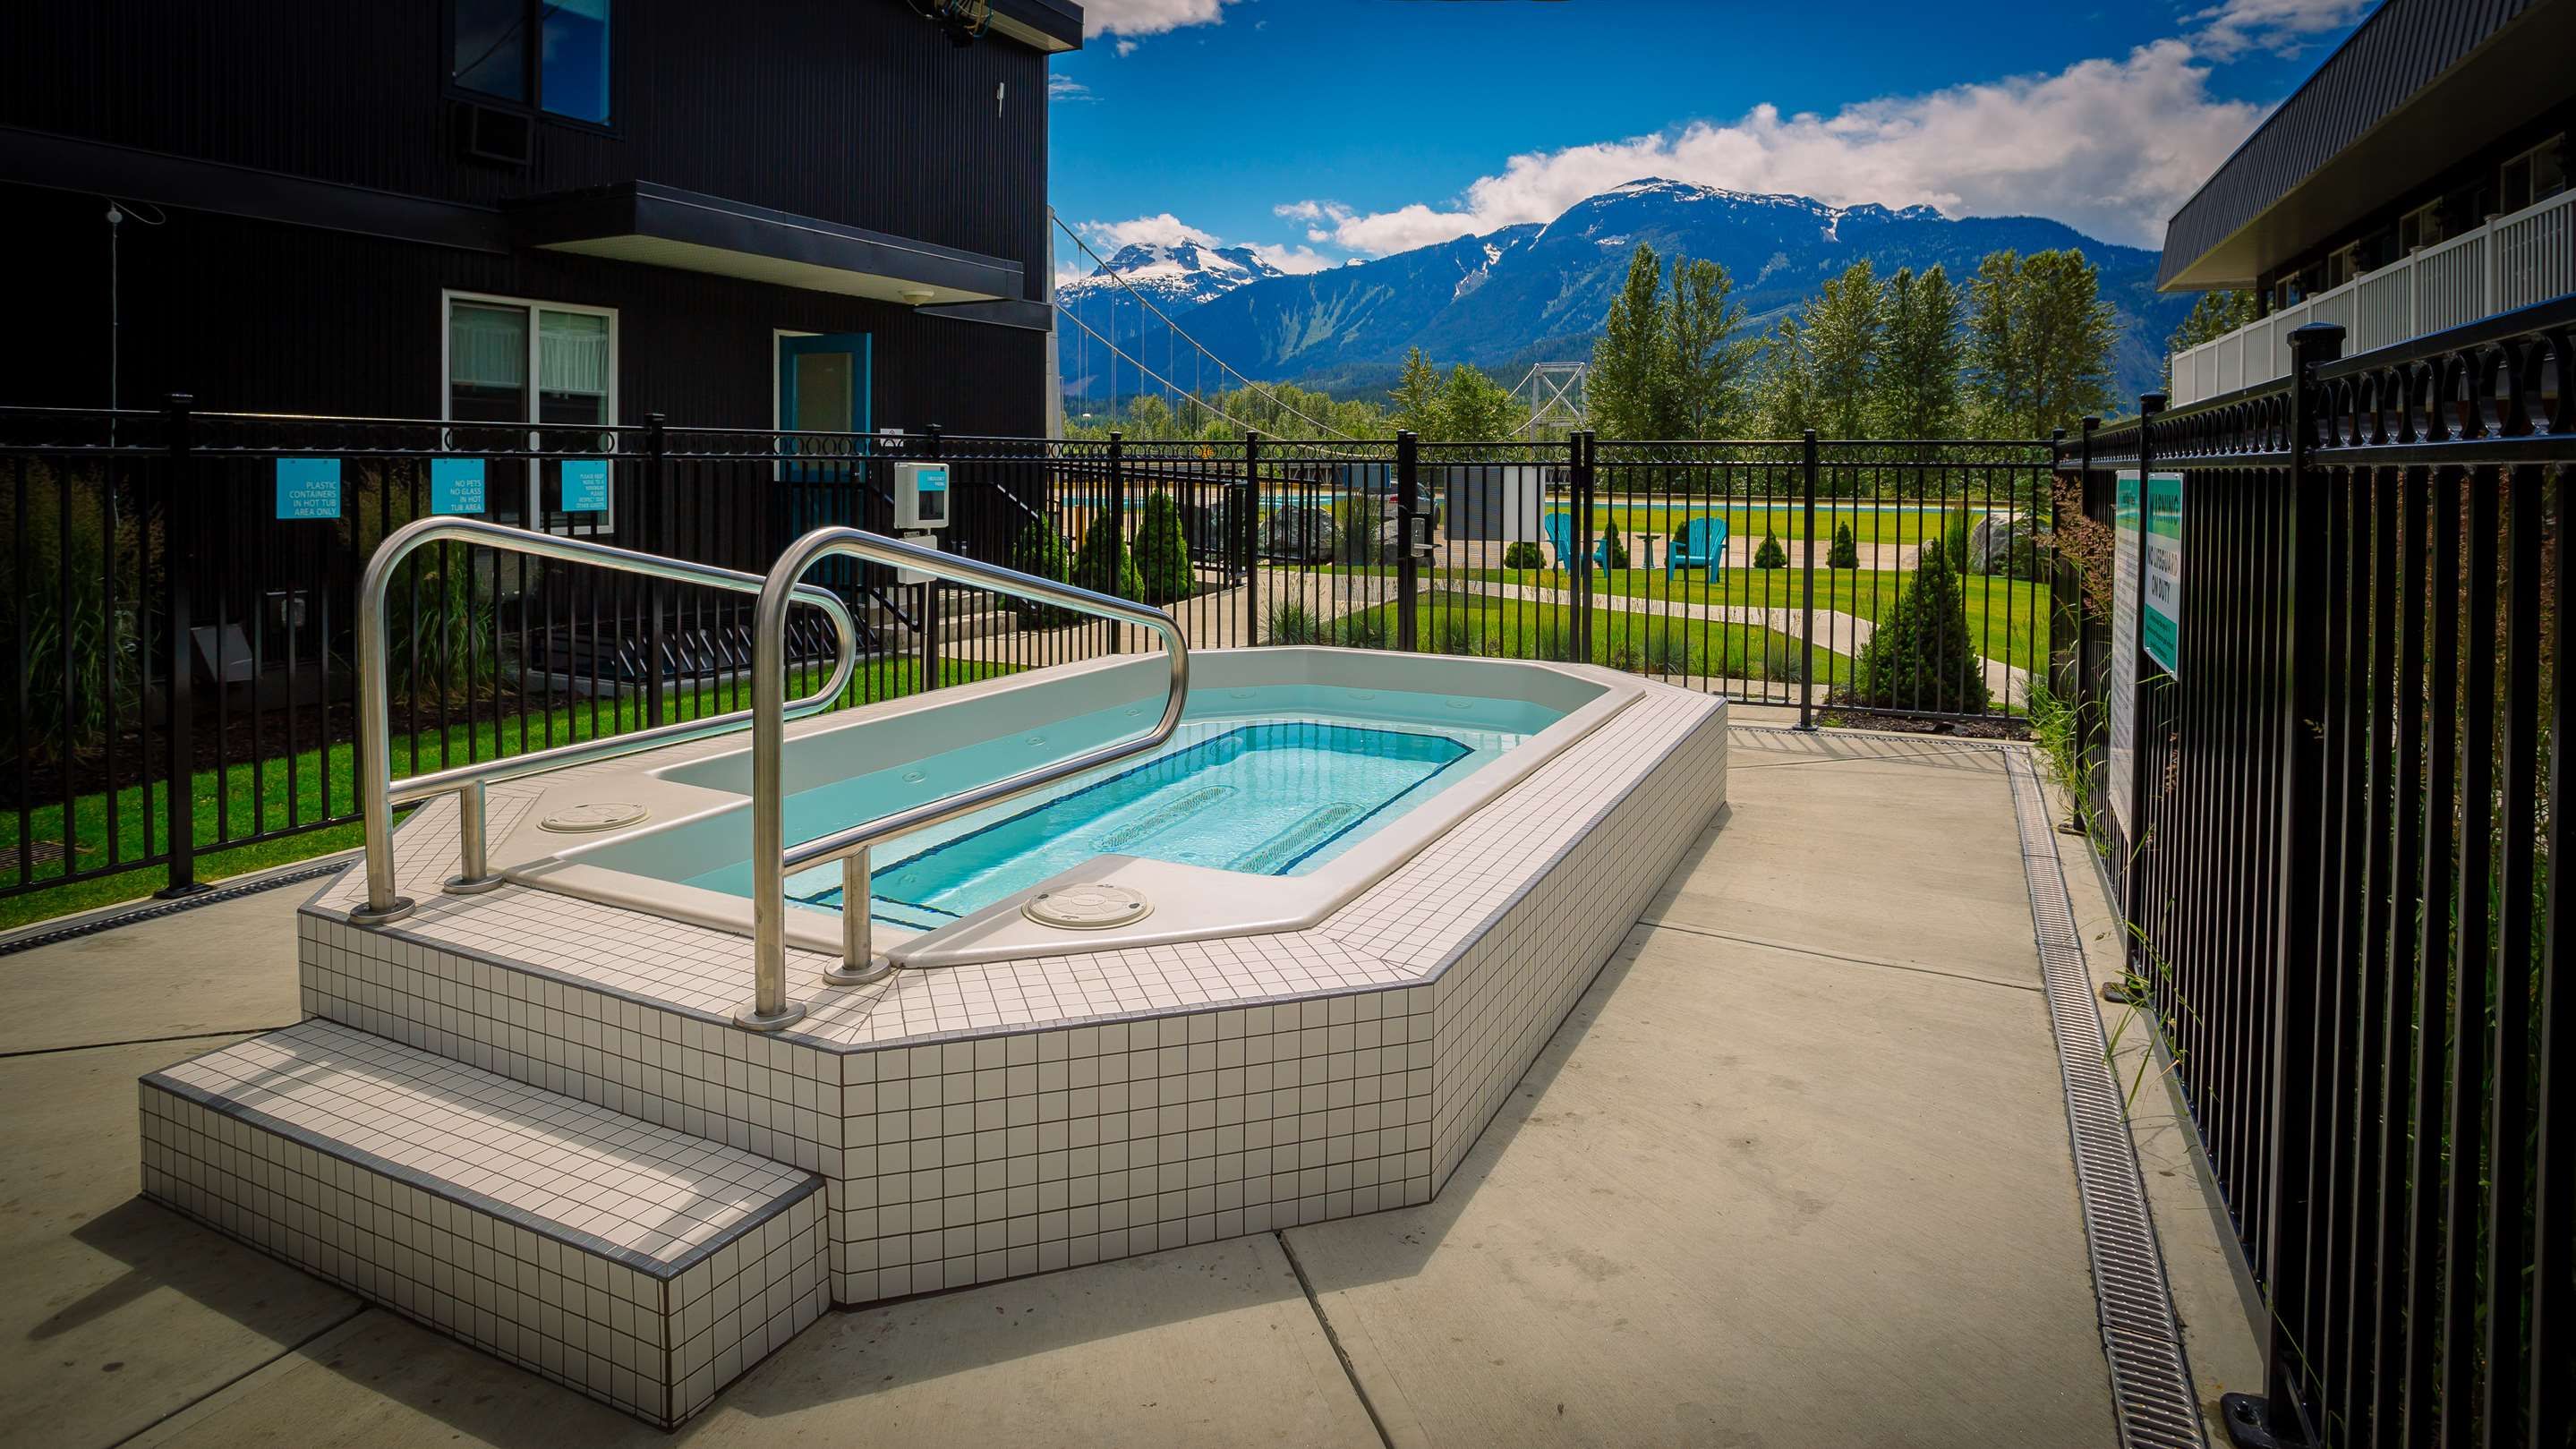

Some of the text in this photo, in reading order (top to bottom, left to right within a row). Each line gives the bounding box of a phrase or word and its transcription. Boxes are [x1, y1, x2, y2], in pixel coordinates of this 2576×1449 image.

[306, 482, 337, 490] PLASTIC
[288, 490, 337, 499] CONTAINERS
[293, 499, 337, 507] IN HOT TUB
[465, 503, 482, 511] AREA
[294, 507, 337, 516] AREA ONLY
[2149, 493, 2179, 525] WARNING
[2147, 543, 2178, 577] NO LIFEGUARD
[2151, 574, 2171, 604] ON DUTY
